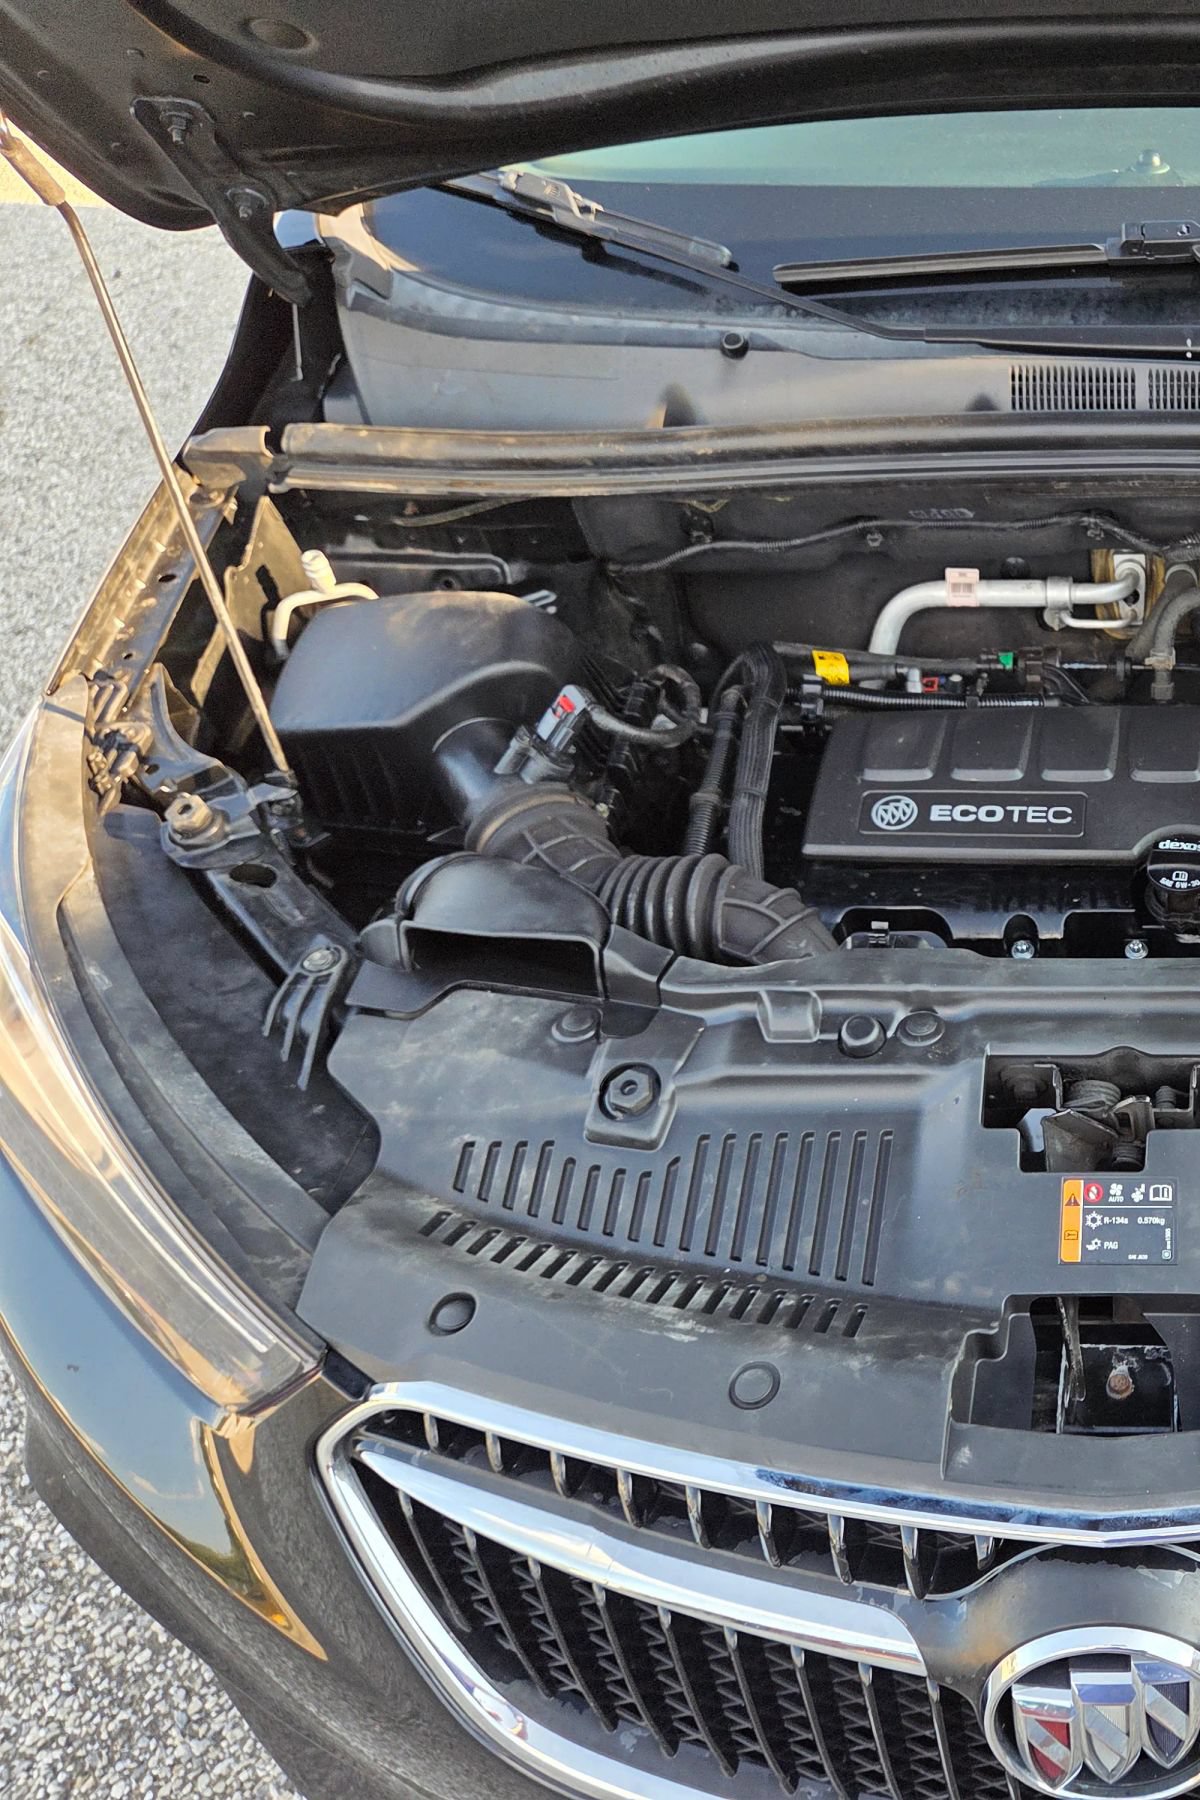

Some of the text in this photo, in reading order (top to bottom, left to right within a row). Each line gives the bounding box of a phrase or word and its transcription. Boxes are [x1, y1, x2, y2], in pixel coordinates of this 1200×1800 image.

[929, 804, 1073, 824] ECOTEC
[1108, 1195, 1124, 1203] AUTO
[1103, 1241, 1119, 1250] PAG
